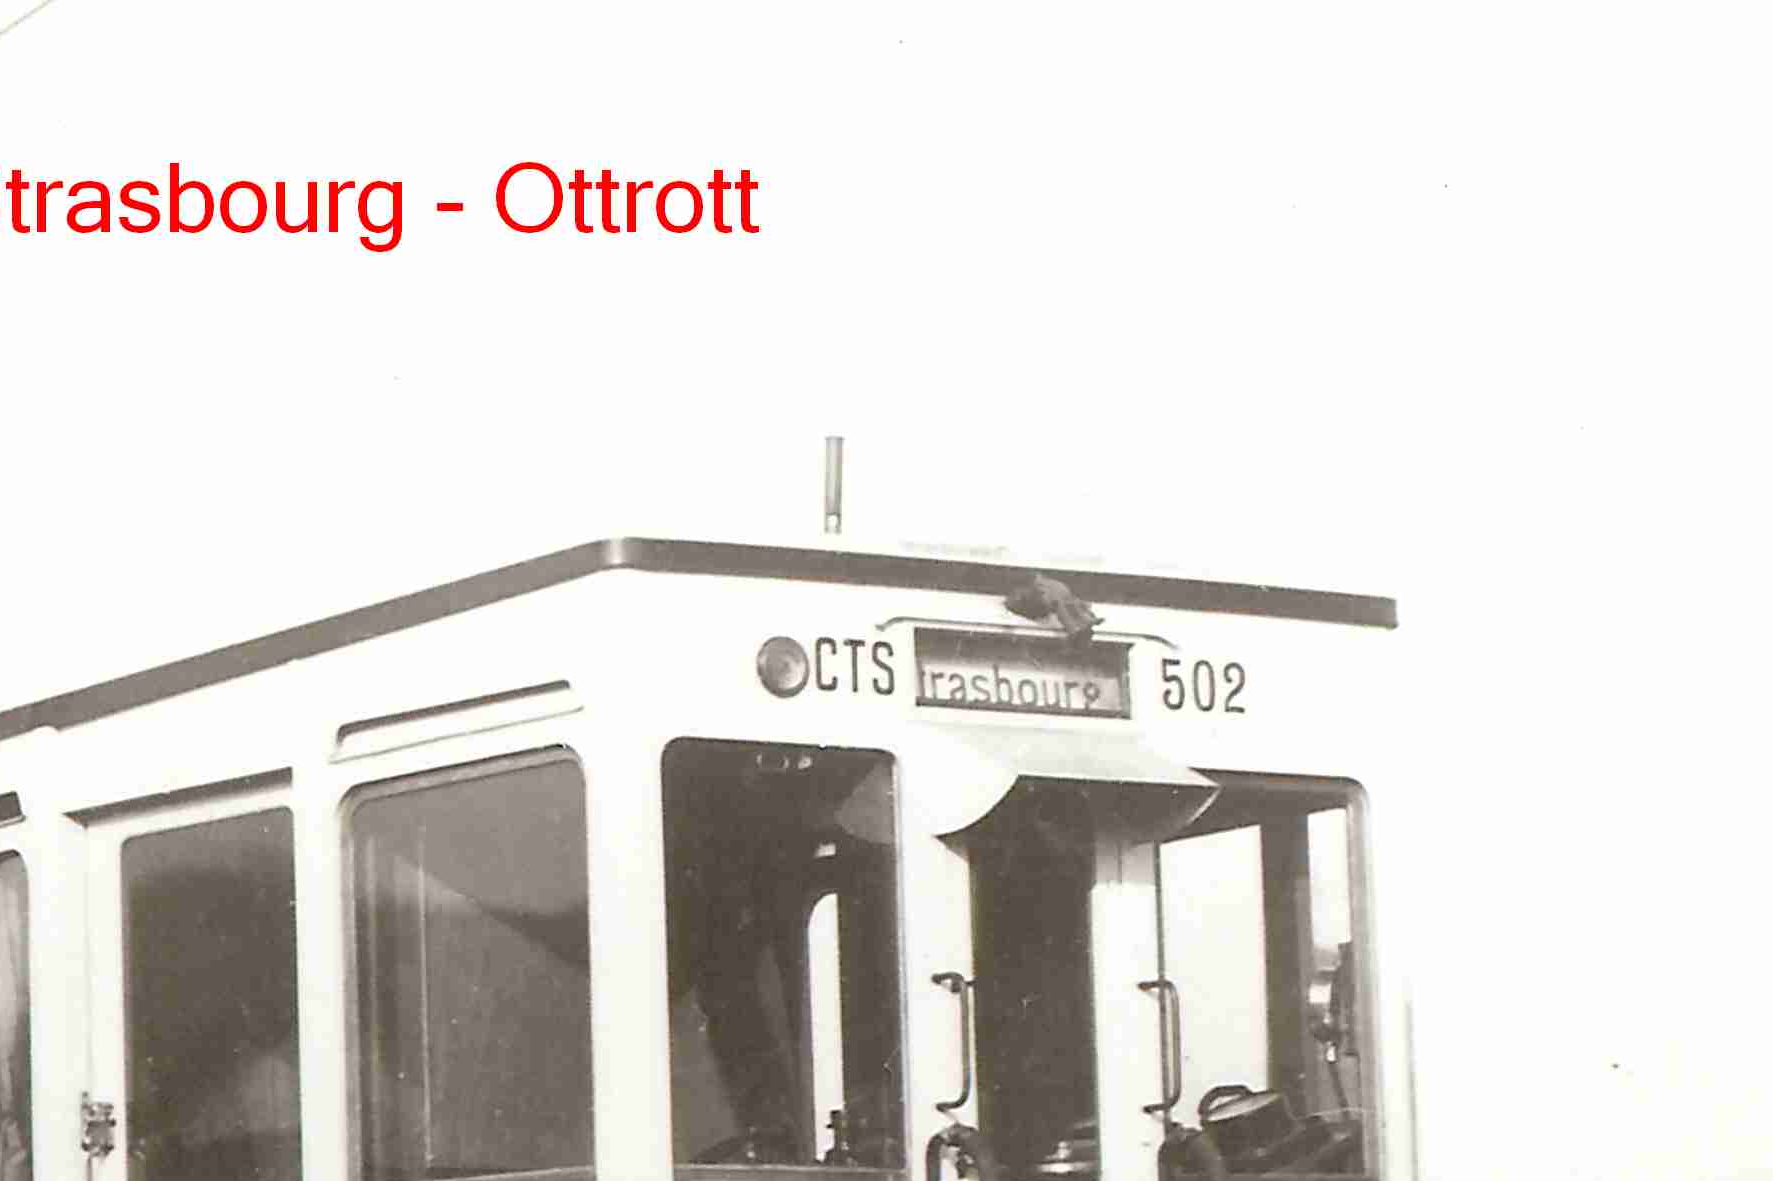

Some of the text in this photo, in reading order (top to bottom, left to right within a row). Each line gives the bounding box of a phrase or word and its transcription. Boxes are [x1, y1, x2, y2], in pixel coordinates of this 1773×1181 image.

[815, 637, 1245, 714] CTS rasbourg 502
